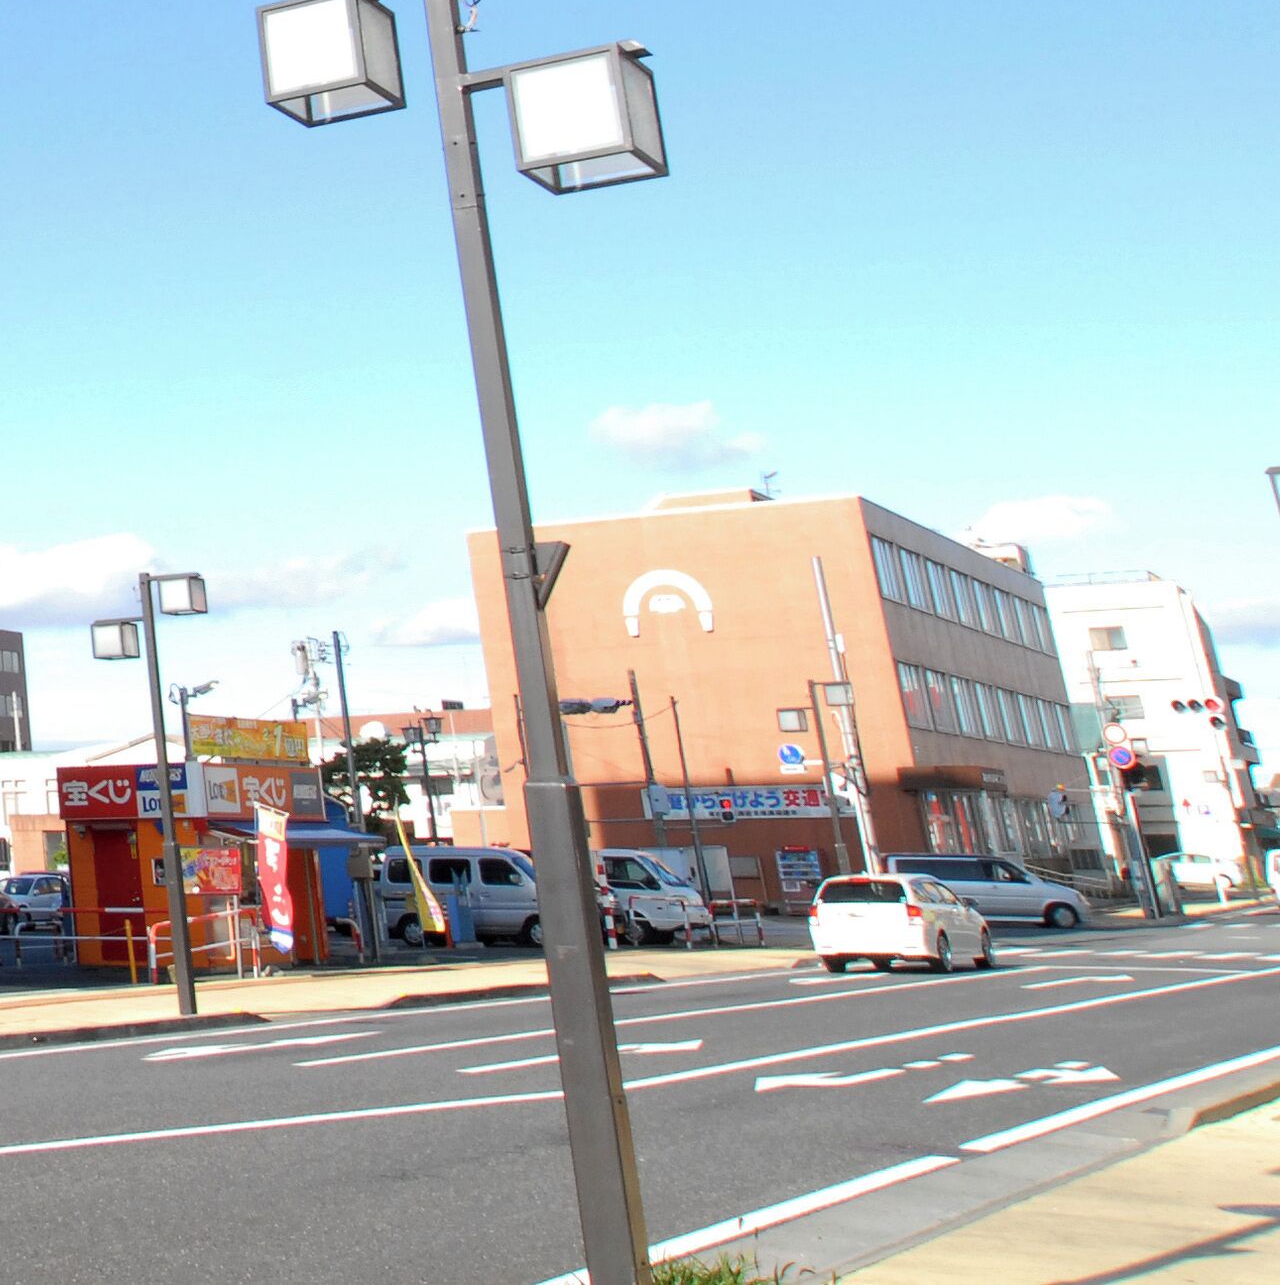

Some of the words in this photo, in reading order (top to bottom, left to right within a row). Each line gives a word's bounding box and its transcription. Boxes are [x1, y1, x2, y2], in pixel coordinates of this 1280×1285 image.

[62, 779, 132, 807] 宝くじ
[242, 775, 286, 807] 宝くじ
